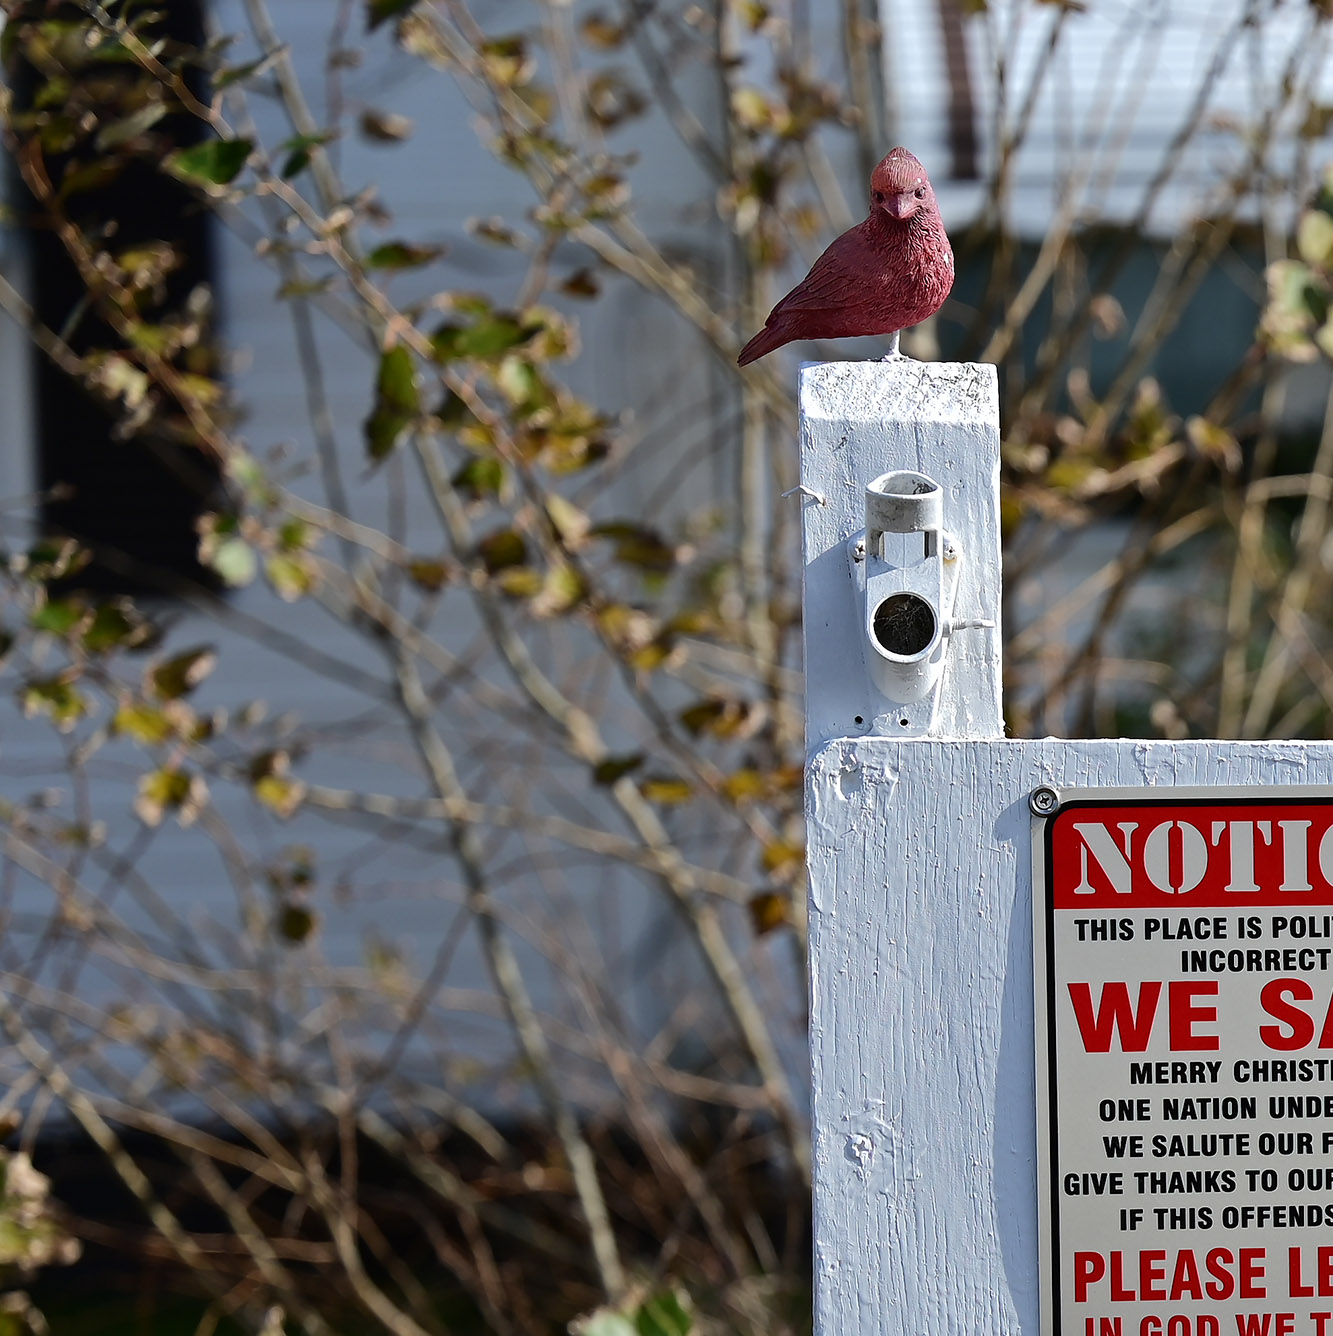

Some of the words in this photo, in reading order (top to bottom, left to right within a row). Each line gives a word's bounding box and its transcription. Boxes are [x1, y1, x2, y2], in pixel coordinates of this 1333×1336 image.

[1074, 918, 1134, 941] THIS
[1144, 917, 1227, 940] PLACE
[1237, 916, 1262, 939] IS
[1181, 948, 1332, 973] INCORRECT
[1067, 980, 1220, 1053] WE
[1129, 1060, 1222, 1085] MERRY
[1099, 1098, 1151, 1122] ONE
[1163, 1096, 1257, 1121] NATION
[1103, 1135, 1144, 1158] WE
[1152, 1133, 1250, 1157] SALUTE
[1258, 1132, 1314, 1156] OUR
[1064, 1172, 1124, 1196] GIVE
[1134, 1170, 1236, 1194] THANKS
[1245, 1168, 1278, 1192] TO
[1119, 1208, 1143, 1231] IF
[1153, 1207, 1213, 1230] THIS
[1073, 1247, 1267, 1303] PLEASE
